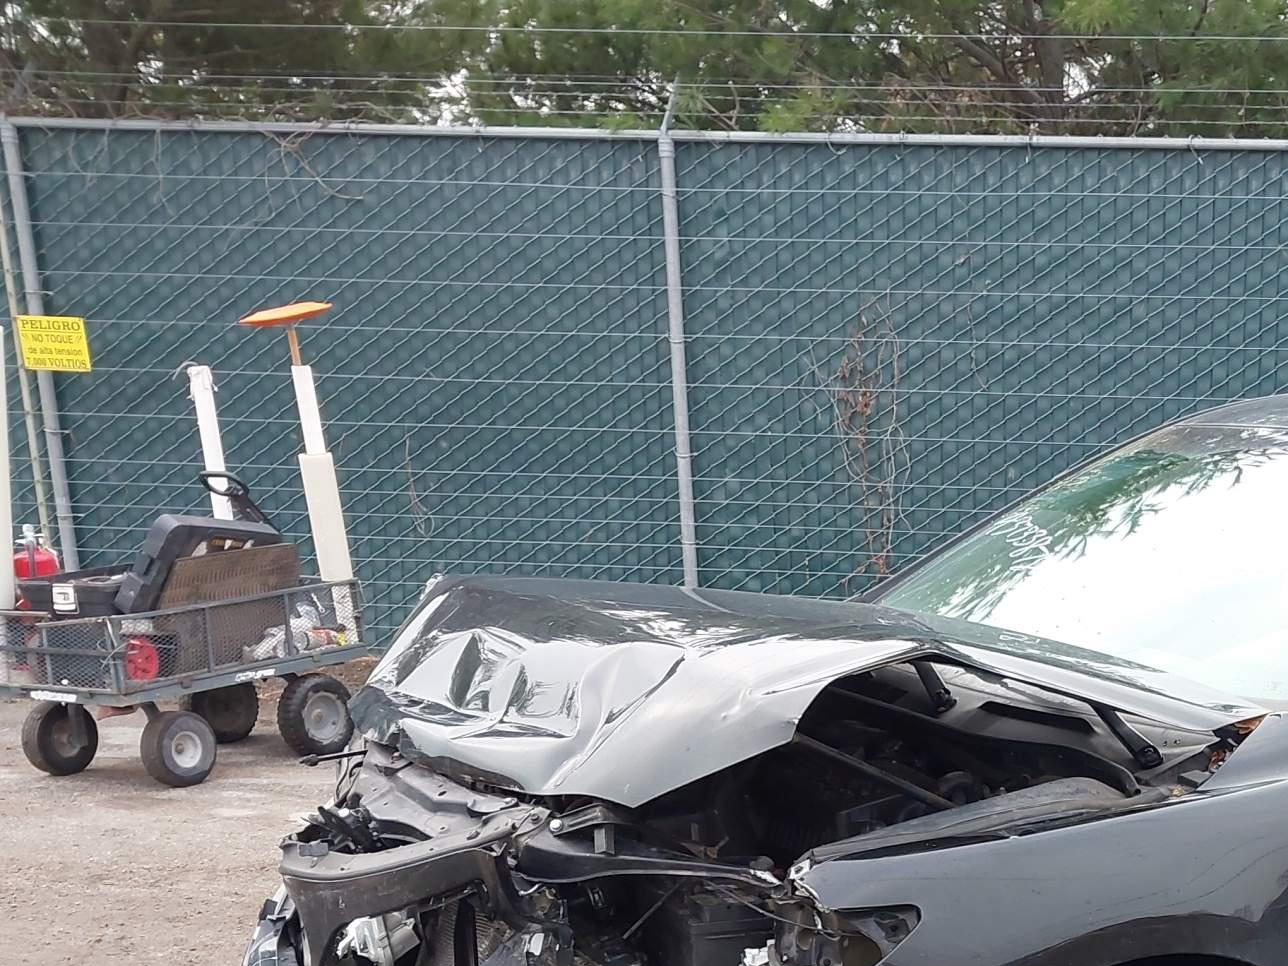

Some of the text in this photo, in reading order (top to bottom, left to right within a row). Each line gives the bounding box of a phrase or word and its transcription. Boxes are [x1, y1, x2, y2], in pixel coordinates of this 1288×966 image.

[21, 319, 81, 331] PELIGRO
[31, 334, 74, 345] NO TOQUE
[47, 358, 88, 369] VOLTIOS
